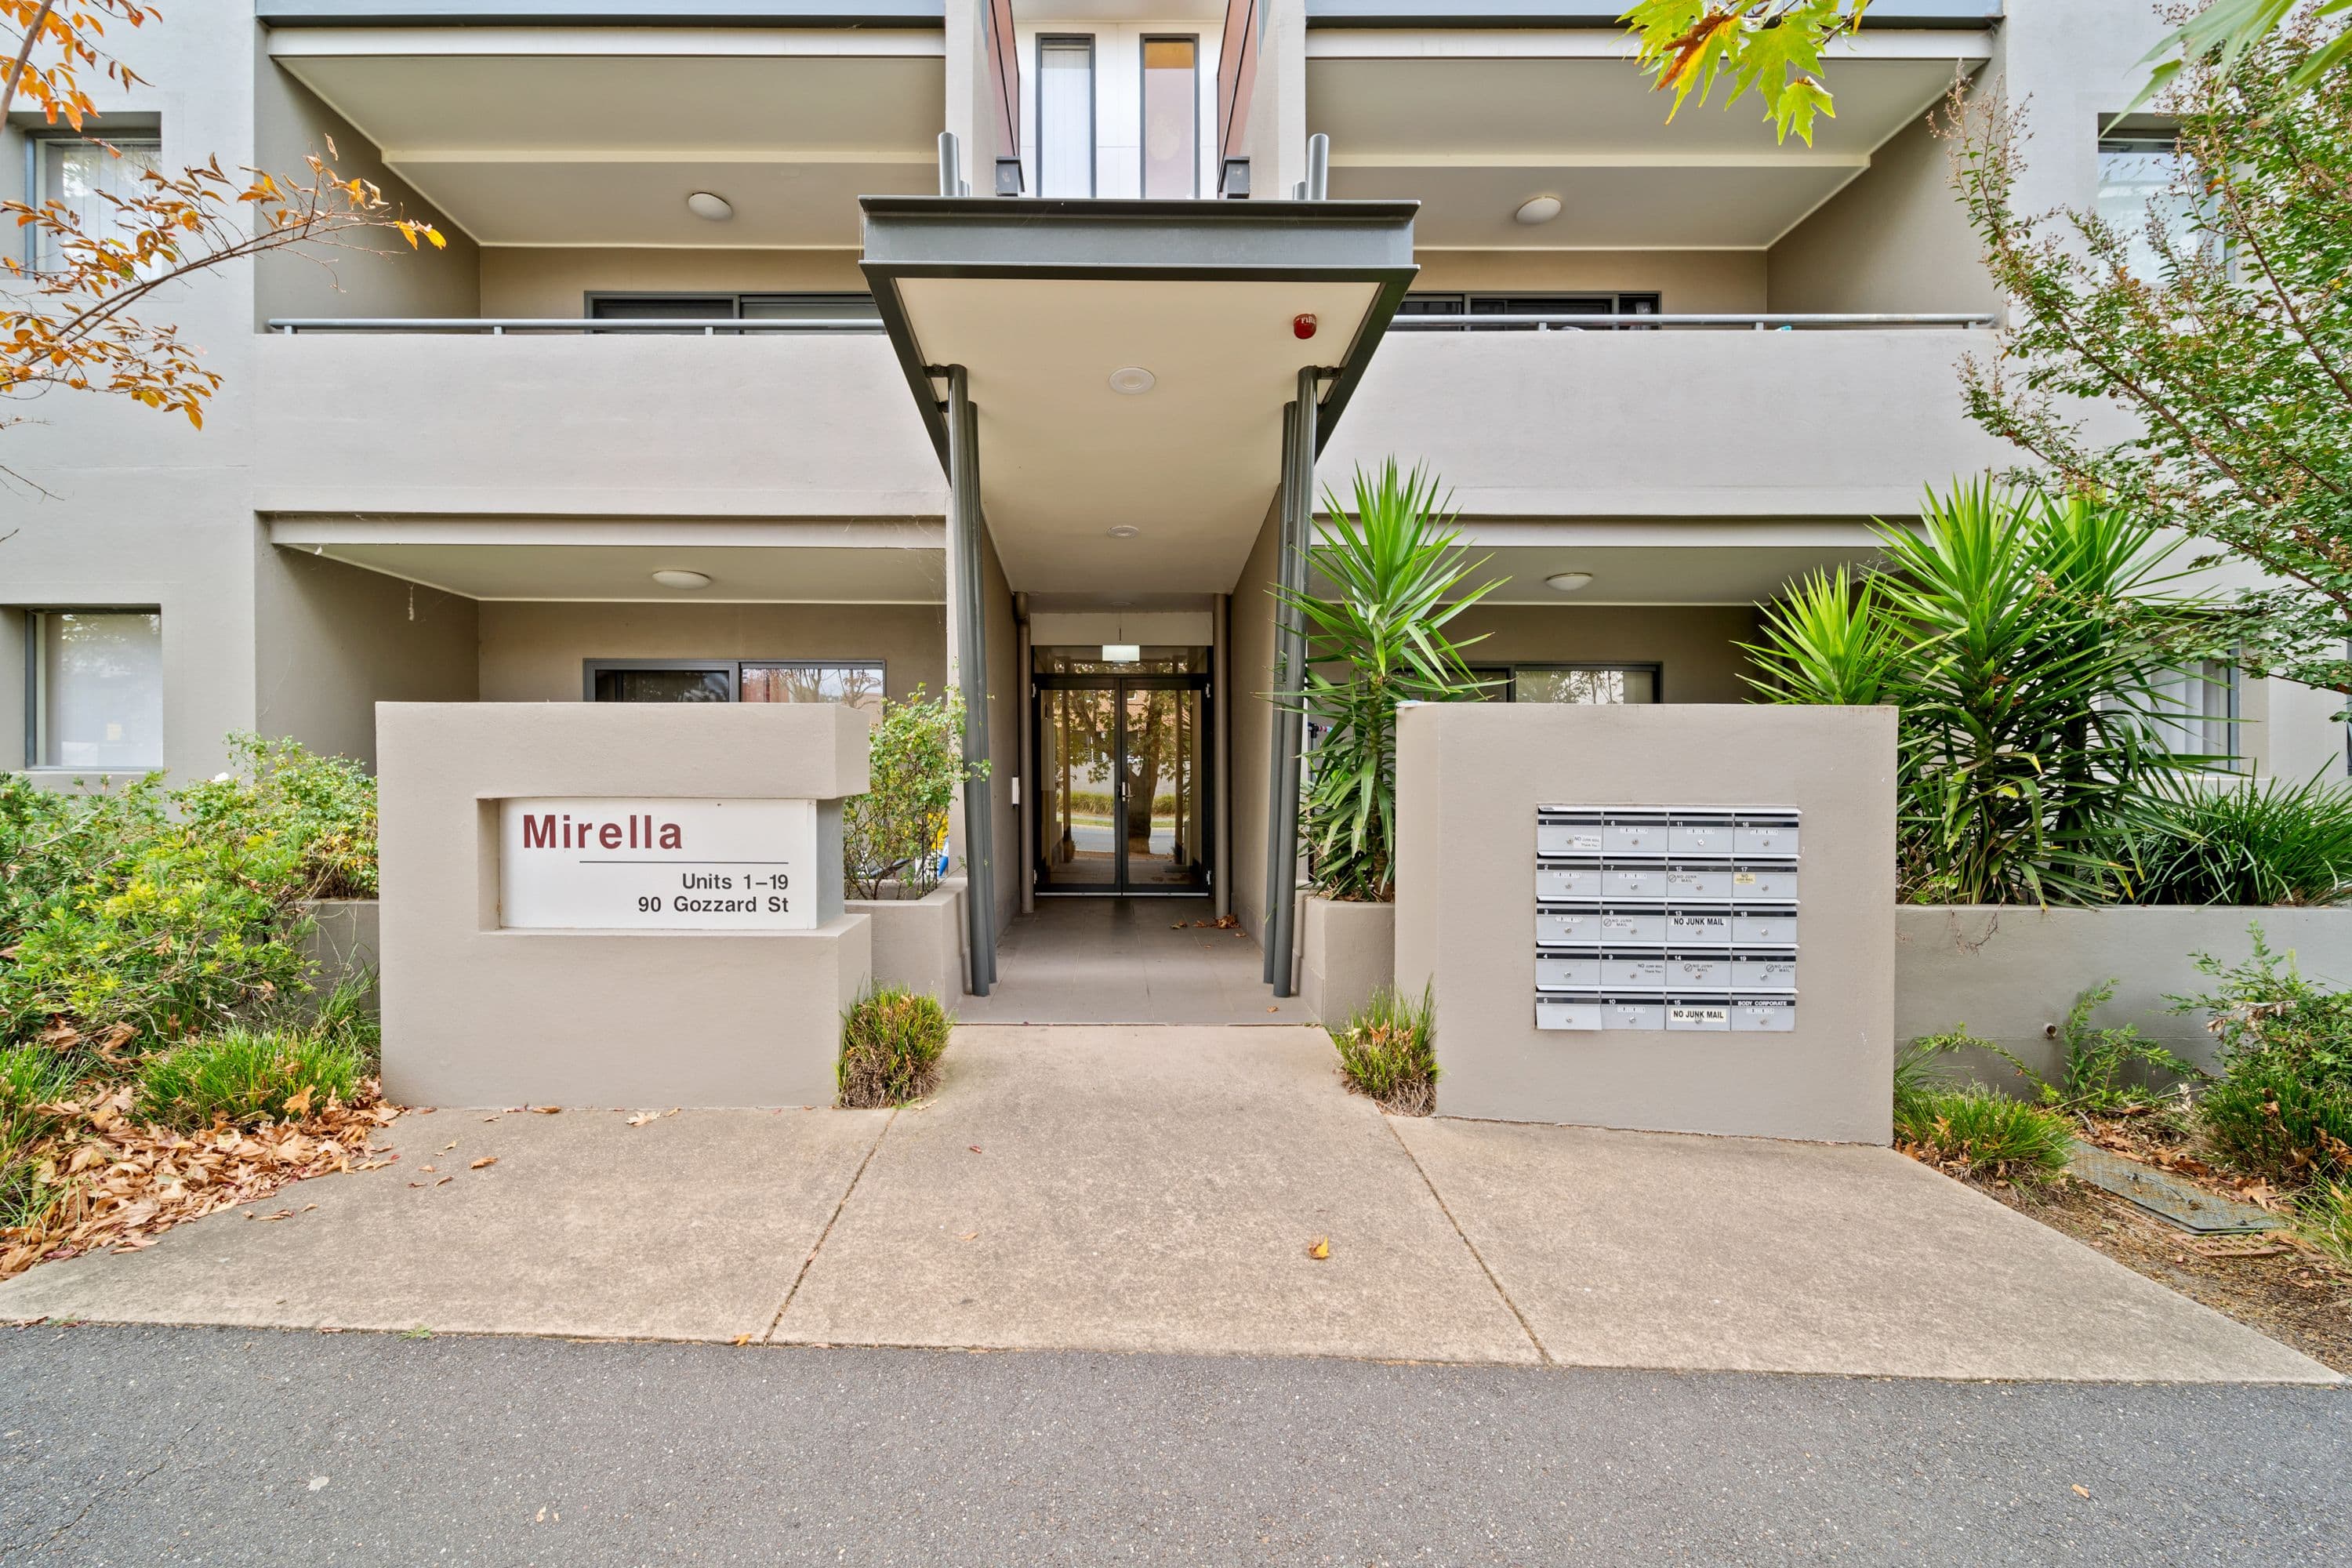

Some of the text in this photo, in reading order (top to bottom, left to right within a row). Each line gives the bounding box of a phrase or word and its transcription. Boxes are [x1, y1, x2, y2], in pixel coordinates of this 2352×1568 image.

[523, 815, 682, 849] Mirella
[682, 873, 732, 890] Units
[637, 895, 789, 913] 90 Gozzard St
